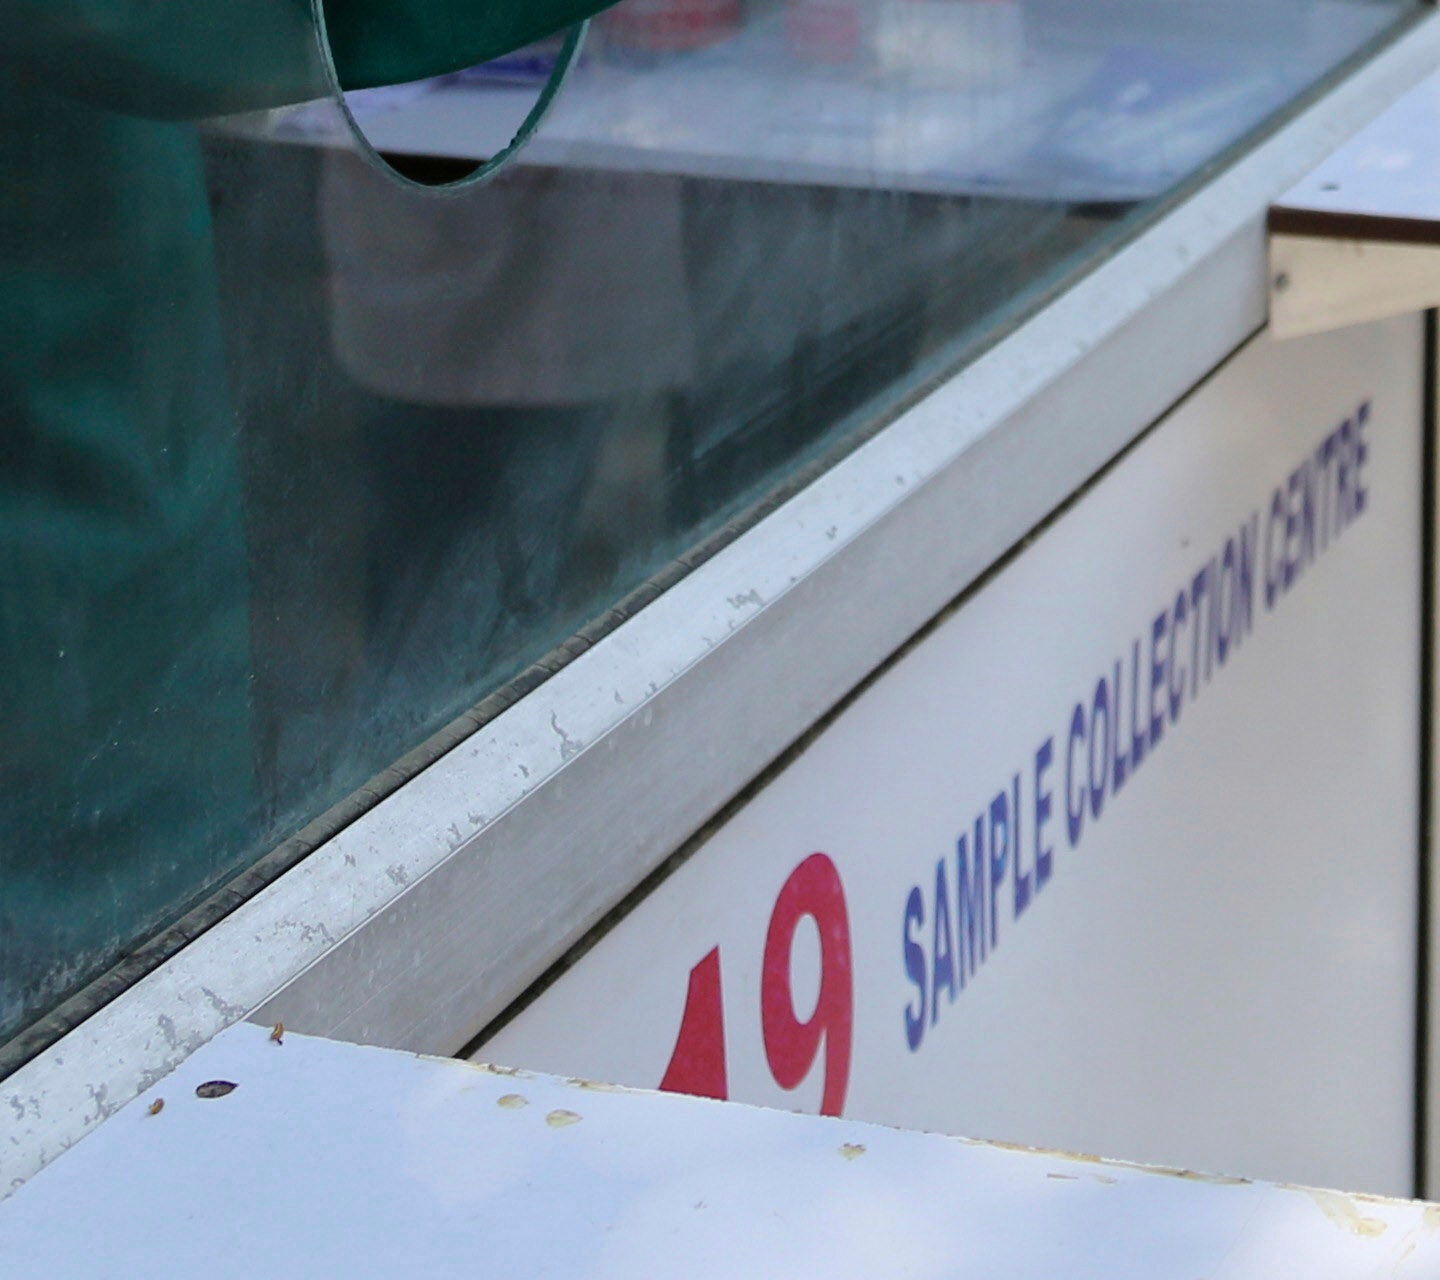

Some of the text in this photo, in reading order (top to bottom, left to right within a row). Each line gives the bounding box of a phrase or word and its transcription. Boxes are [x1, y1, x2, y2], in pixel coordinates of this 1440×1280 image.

[903, 398, 1372, 1052] SAMPLE COLLECTION CENTRE
